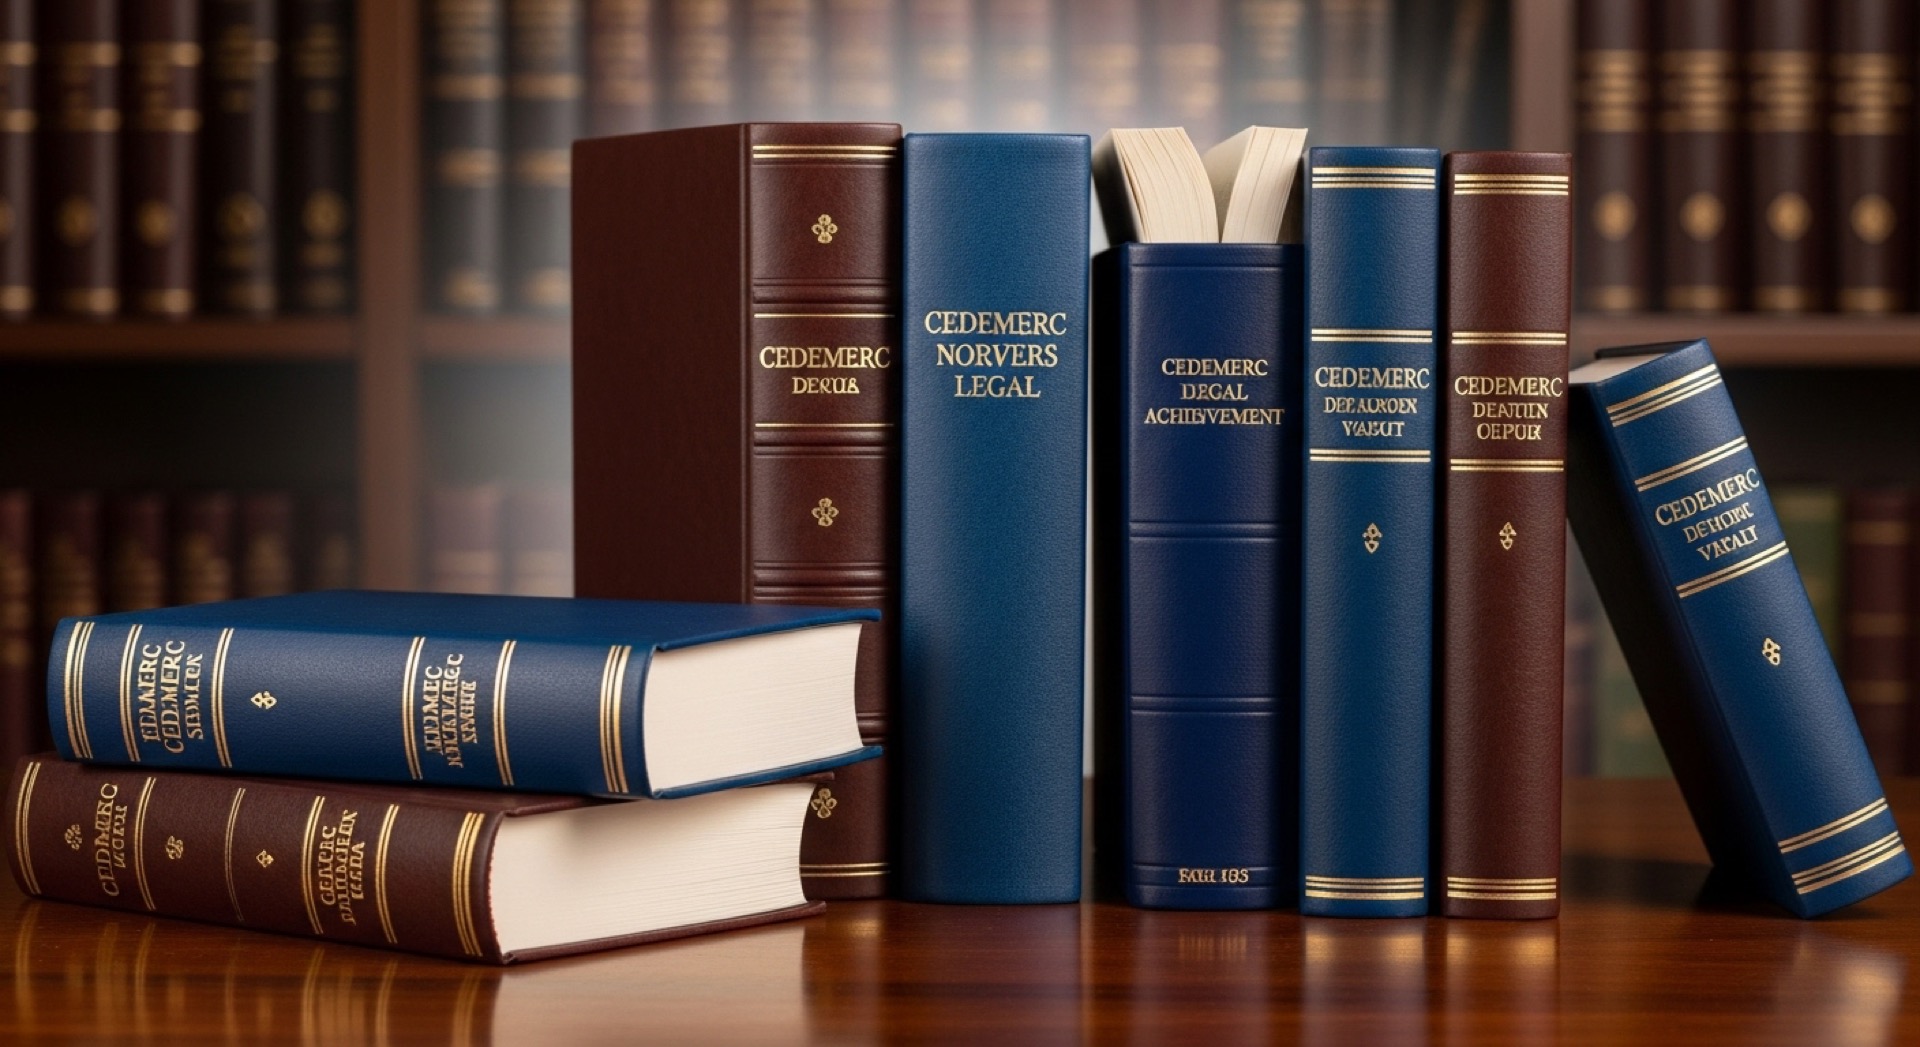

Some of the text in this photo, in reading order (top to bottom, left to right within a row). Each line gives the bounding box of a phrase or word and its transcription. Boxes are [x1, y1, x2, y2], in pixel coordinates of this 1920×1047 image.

[924, 311, 1067, 336] CEDEMERC
[759, 346, 890, 369] CEDEMERC
[936, 343, 1058, 367] NORVERS
[1161, 358, 1268, 376] CEDEMERC
[1314, 367, 1430, 389] CEDEMERC
[954, 375, 1041, 398] LEGAL
[1454, 376, 1564, 397] CEDEMERC
[1655, 468, 1760, 526] CEDEMERC
